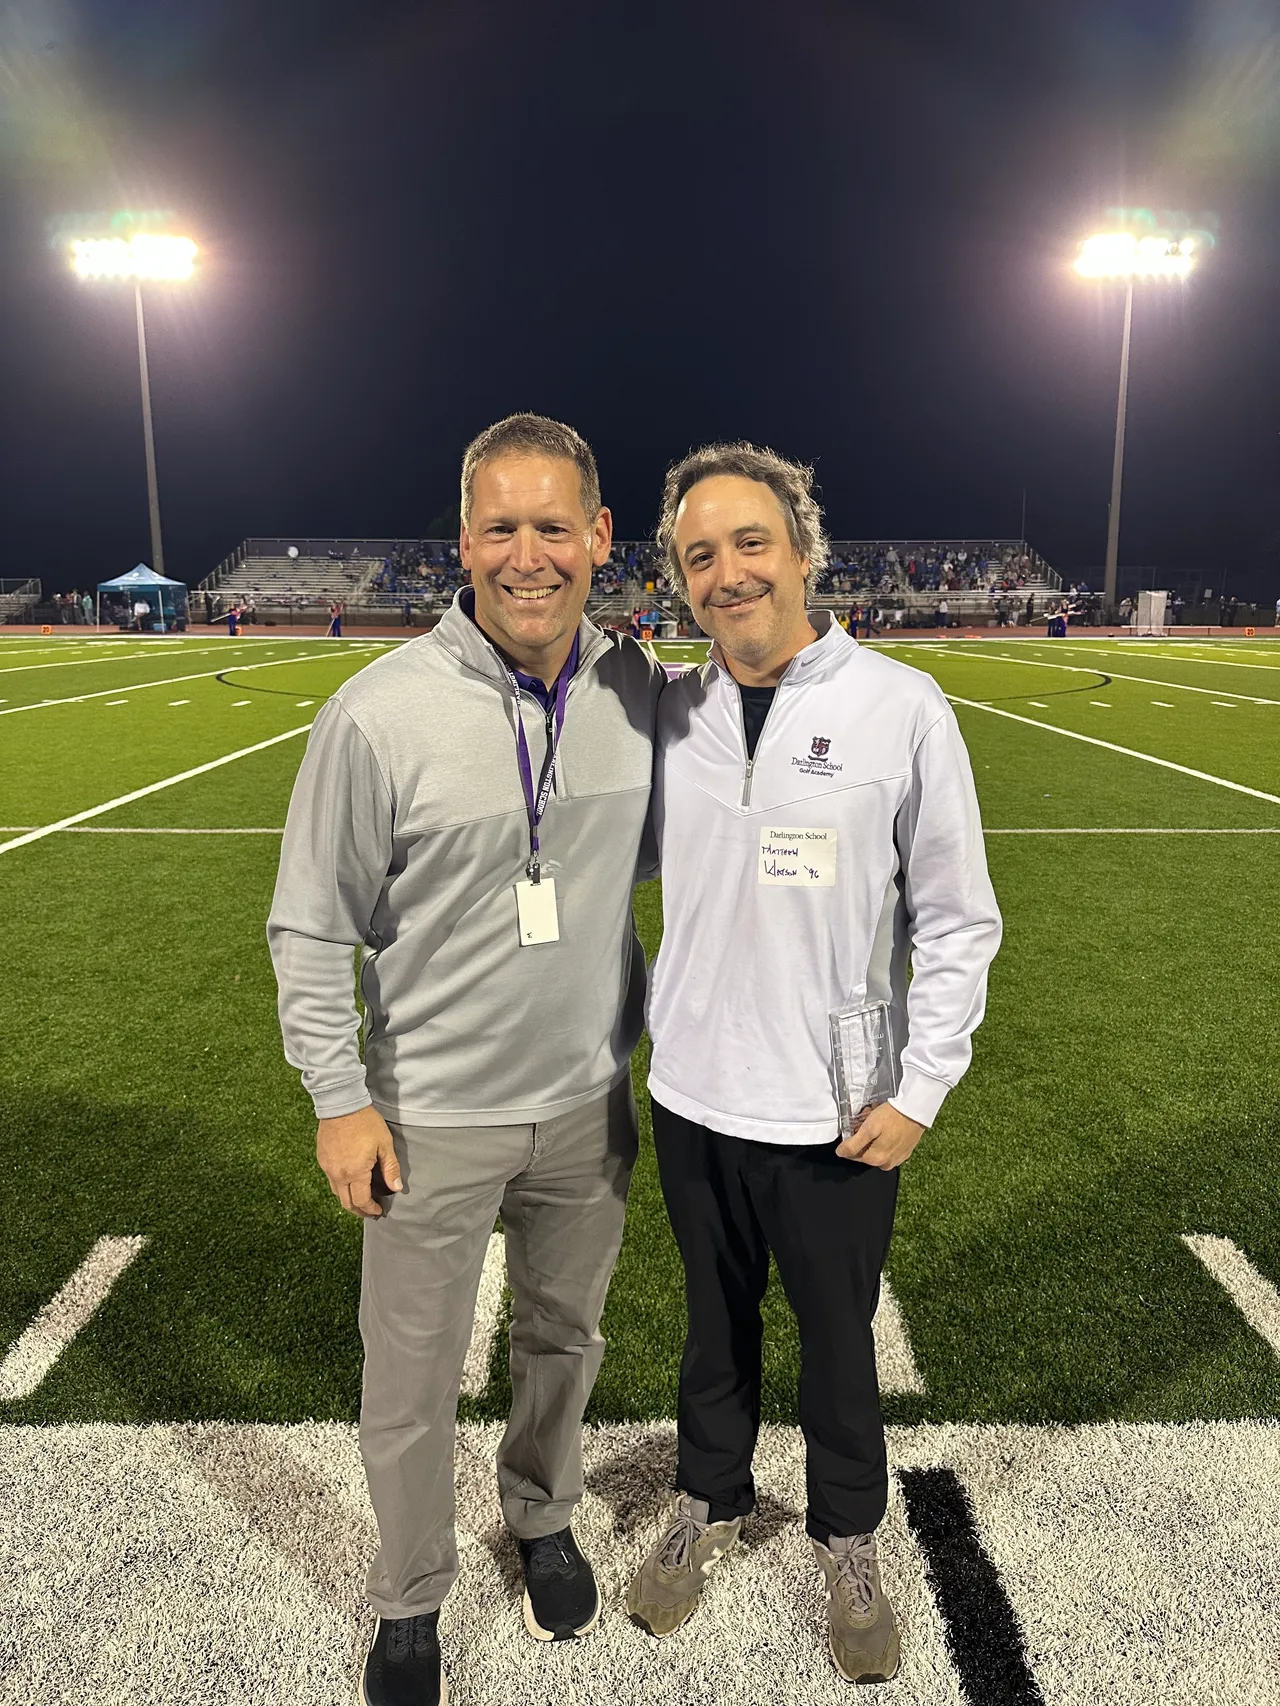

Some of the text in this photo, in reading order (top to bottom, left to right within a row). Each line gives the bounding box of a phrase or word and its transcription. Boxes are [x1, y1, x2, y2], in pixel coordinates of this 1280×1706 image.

[791, 756, 843, 772] Darlington School
[810, 769, 834, 778] Academy
[536, 791, 549, 817] SCHOOL
[770, 830, 827, 841] Darlington School
